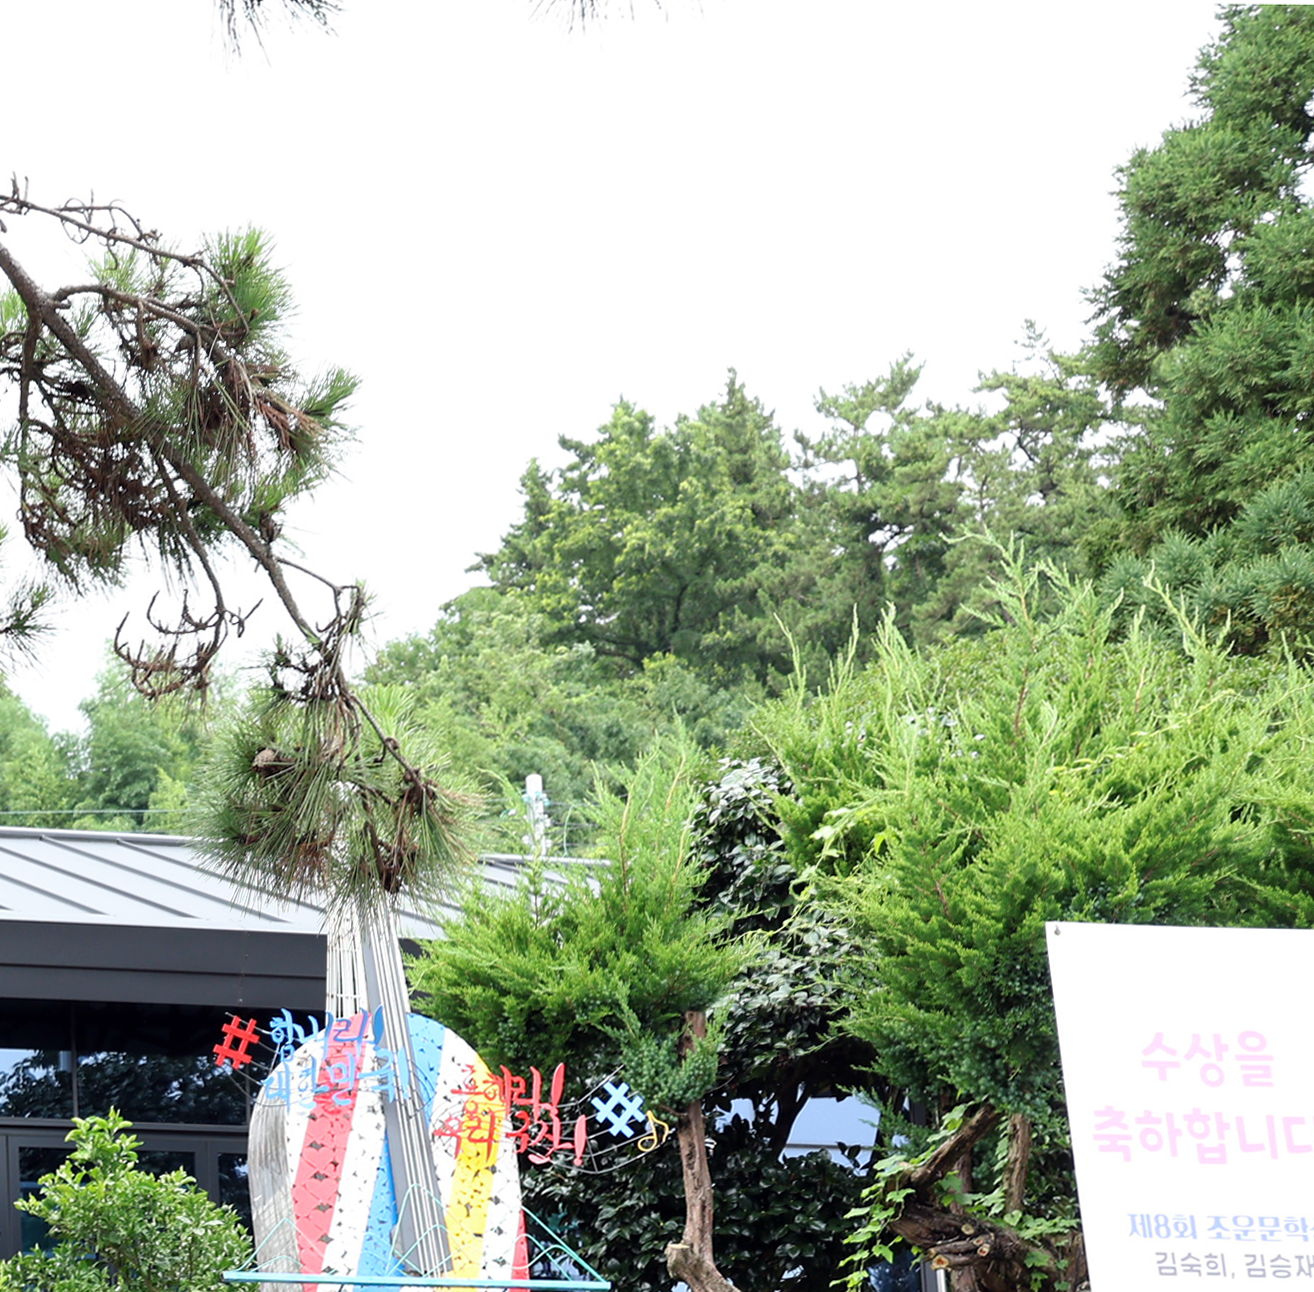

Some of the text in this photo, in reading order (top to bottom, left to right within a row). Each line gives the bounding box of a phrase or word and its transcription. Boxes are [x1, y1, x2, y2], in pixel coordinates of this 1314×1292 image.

[1141, 1030, 1274, 1088] 수상을
[1127, 1212, 1314, 1242] 제8회 조운문학
[1155, 1252, 1235, 1279] 김숙희,
